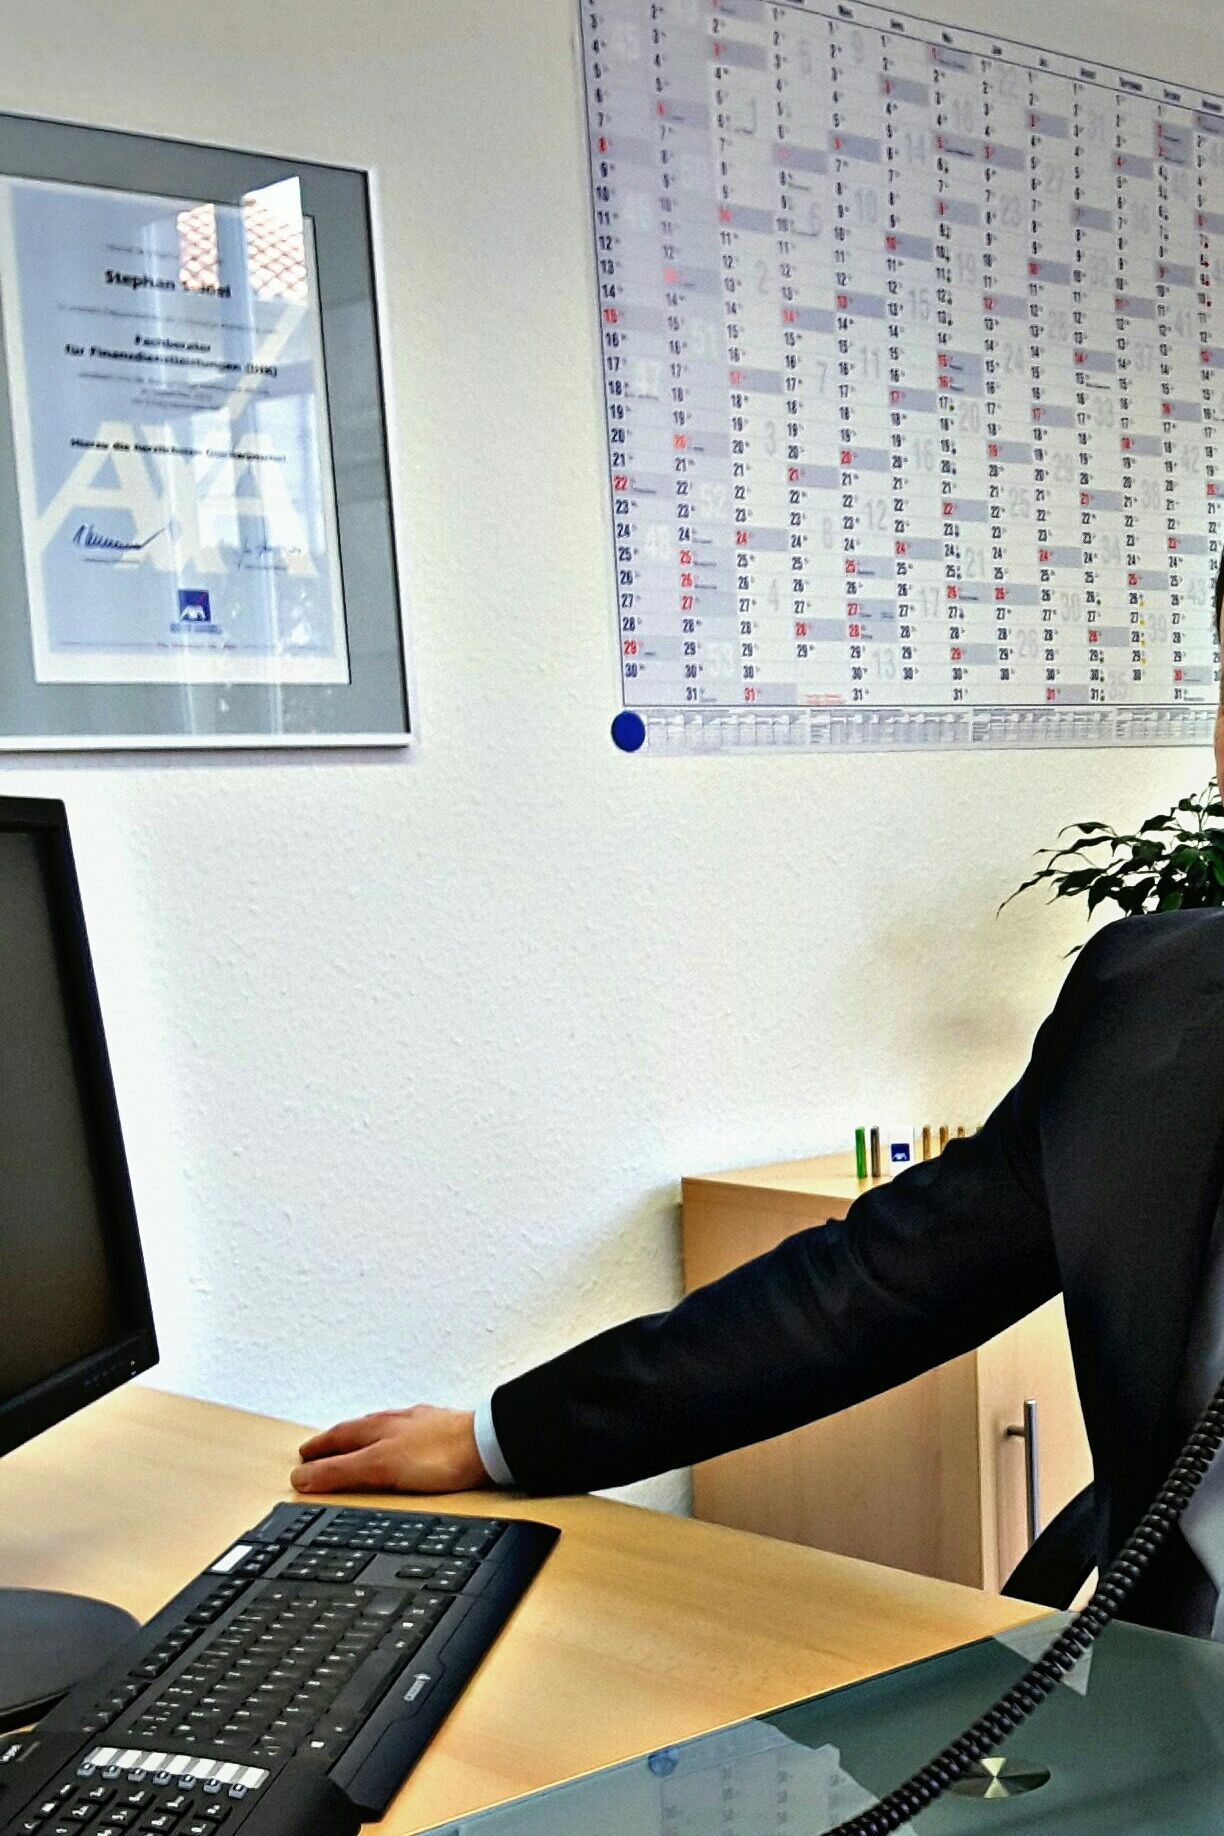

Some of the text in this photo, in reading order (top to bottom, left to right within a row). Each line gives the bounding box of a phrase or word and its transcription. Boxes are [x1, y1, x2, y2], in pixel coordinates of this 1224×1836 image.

[599, 211, 610, 225] 11
[599, 235, 612, 251] 12
[722, 231, 733, 245] 11
[779, 241, 790, 254] 11
[600, 259, 614, 275] 13
[723, 255, 734, 269] 12
[780, 263, 791, 278] 12
[602, 284, 616, 298] 14
[726, 302, 737, 314] 14
[727, 324, 739, 339] 15
[606, 332, 619, 347] 16
[784, 332, 795, 346] 15
[669, 340, 681, 355] 16
[729, 347, 740, 362] 16
[608, 356, 620, 371] 17
[609, 381, 622, 395] 18
[786, 377, 796, 391] 17
[611, 404, 624, 419] 19
[673, 411, 685, 425] 19
[732, 417, 743, 431] 19
[788, 423, 798, 437] 19
[611, 428, 625, 443] 20
[732, 440, 744, 454] 20
[788, 445, 799, 459] 20
[613, 452, 625, 467] 21
[675, 457, 686, 472] 21
[733, 463, 744, 477] 21
[788, 468, 799, 482] 21
[614, 475, 627, 491] 22
[676, 480, 688, 495] 22
[734, 485, 745, 500] 22
[789, 490, 800, 504] 22
[616, 499, 629, 514] 23
[735, 508, 746, 522] 23
[617, 524, 630, 538] 24
[678, 527, 690, 541] 24
[736, 530, 748, 546] 24
[791, 535, 802, 548] 24
[618, 547, 632, 562] 25
[737, 553, 748, 568] 25
[791, 556, 803, 570] 25
[620, 570, 633, 585] 26
[738, 576, 749, 590] 26
[793, 579, 804, 592] 26
[621, 593, 634, 608] 27
[681, 595, 693, 610] 27
[739, 598, 750, 612] 27
[794, 600, 805, 614] 27
[622, 617, 635, 632] 28
[682, 619, 695, 633] 28
[740, 621, 752, 635] 28
[624, 640, 637, 655] 29
[684, 642, 696, 656] 29
[742, 643, 753, 657] 29
[797, 644, 808, 658] 29
[625, 664, 638, 678] 30
[685, 664, 697, 678] 30
[743, 665, 754, 679] 30
[686, 687, 697, 701] 31
[744, 687, 756, 701] 31
